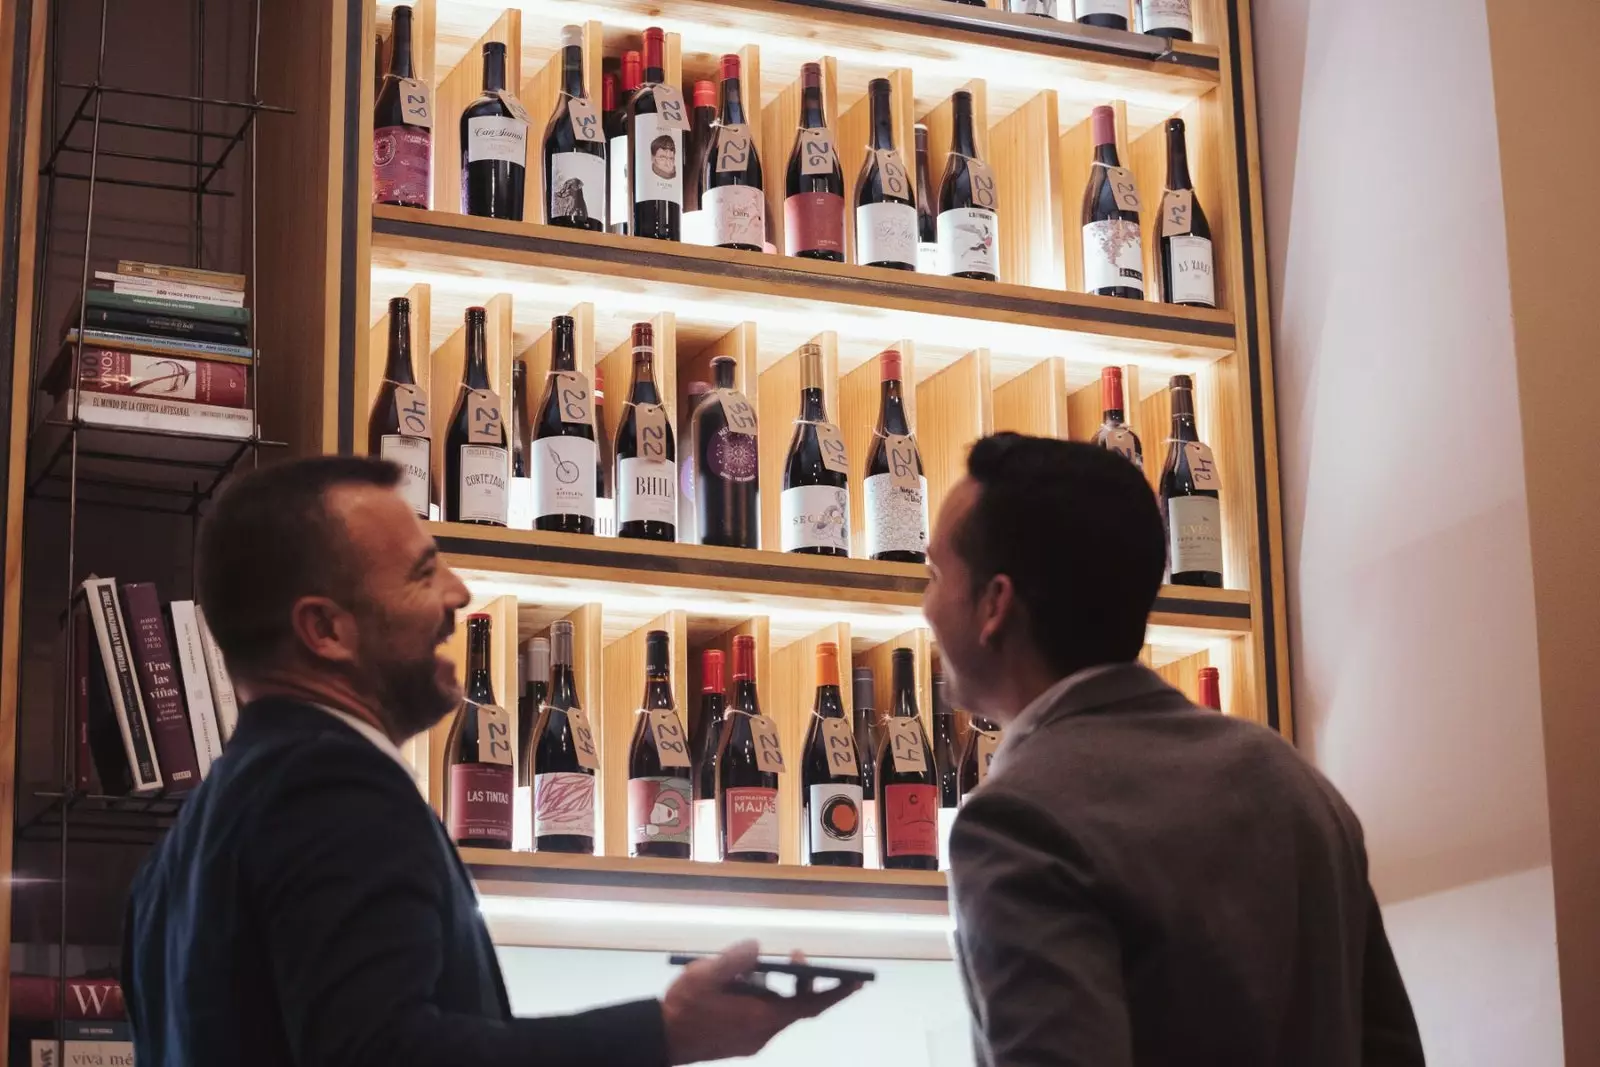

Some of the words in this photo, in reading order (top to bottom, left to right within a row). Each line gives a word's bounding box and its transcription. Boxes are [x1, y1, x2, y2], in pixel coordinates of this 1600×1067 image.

[407, 94, 427, 118] 28
[661, 100, 682, 122] 22
[721, 138, 747, 169] 22
[806, 141, 829, 167] 26
[974, 175, 993, 206] 20
[1117, 182, 1139, 207] 20
[1168, 204, 1187, 226] 24
[100, 350, 113, 389] VINOS
[101, 397, 120, 409] MUNDO
[120, 400, 128, 411] DE
[129, 402, 135, 412] LA
[136, 402, 159, 414] CERVEZA
[160, 404, 190, 417] ARTESANAL
[403, 400, 426, 433] 40
[563, 389, 586, 420] 20
[728, 401, 755, 429] 35
[474, 407, 499, 436] 24
[642, 426, 664, 456] 22
[823, 439, 848, 467] 24
[891, 448, 917, 481] 26
[145, 661, 171, 673] Tras
[153, 674, 169, 685] las
[149, 687, 179, 700] viñas
[487, 722, 510, 758] 22
[577, 727, 595, 756] 24
[656, 723, 684, 754] 28
[759, 732, 783, 765] 22
[830, 735, 851, 767] 22
[895, 731, 921, 762] 24
[467, 790, 484, 803] LAS
[486, 791, 509, 805] TINTAS
[734, 801, 777, 814] MAJAS
